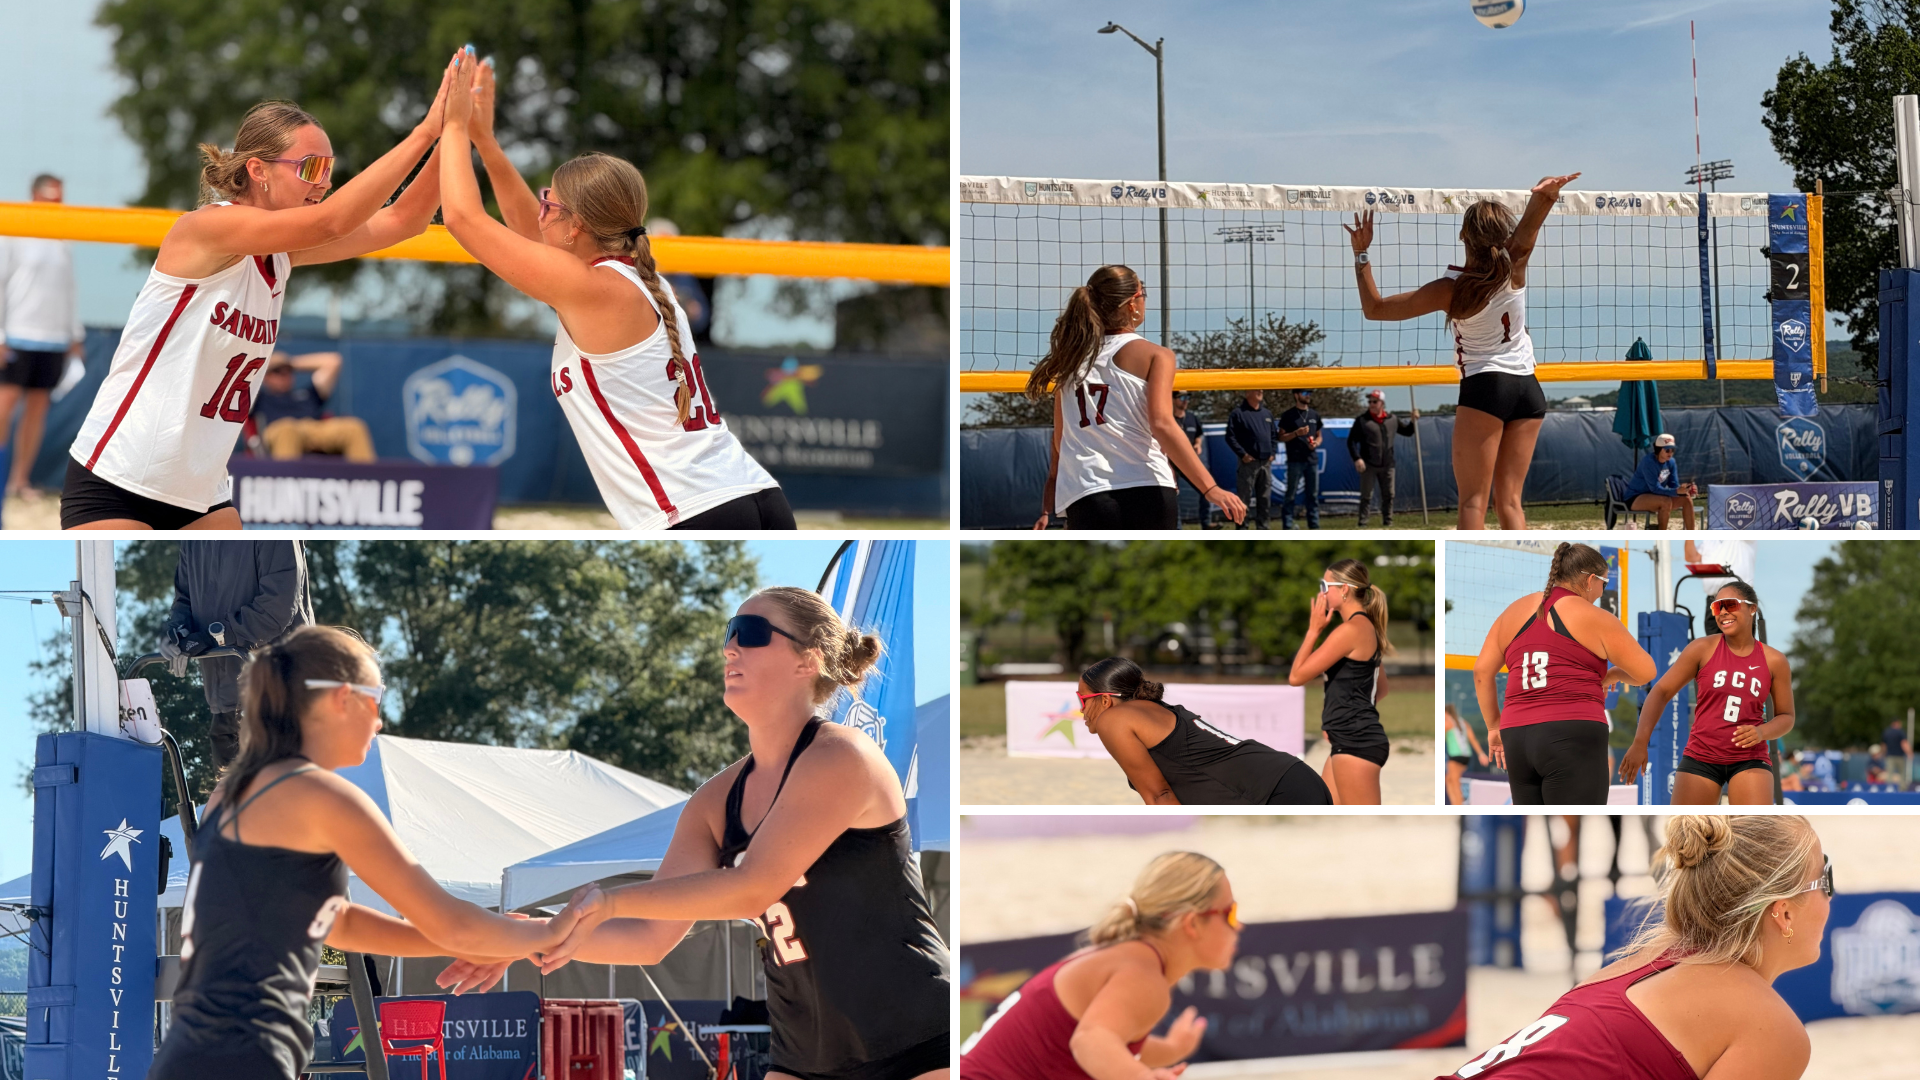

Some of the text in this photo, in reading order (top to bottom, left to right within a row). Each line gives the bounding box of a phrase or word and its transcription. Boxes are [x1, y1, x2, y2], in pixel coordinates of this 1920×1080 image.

[1039, 183, 1073, 192] HUNTSVILLE
[1300, 190, 1331, 198] HUNTSVILLE
[1786, 263, 1799, 290] 2
[1782, 324, 1804, 337] Rally
[200, 352, 266, 424] 16
[1075, 383, 1109, 428] 17
[1780, 427, 1822, 452] Rally
[239, 475, 425, 527] HUNTSVILLE
[1728, 499, 1755, 514] Rally
[1522, 651, 1549, 690] 13
[1713, 670, 1762, 697] SCC
[1723, 695, 1742, 723] 6
[392, 1018, 528, 1037] HUNTSVILLE
[453, 1046, 466, 1060] of
[471, 1045, 521, 1060] Alabama
